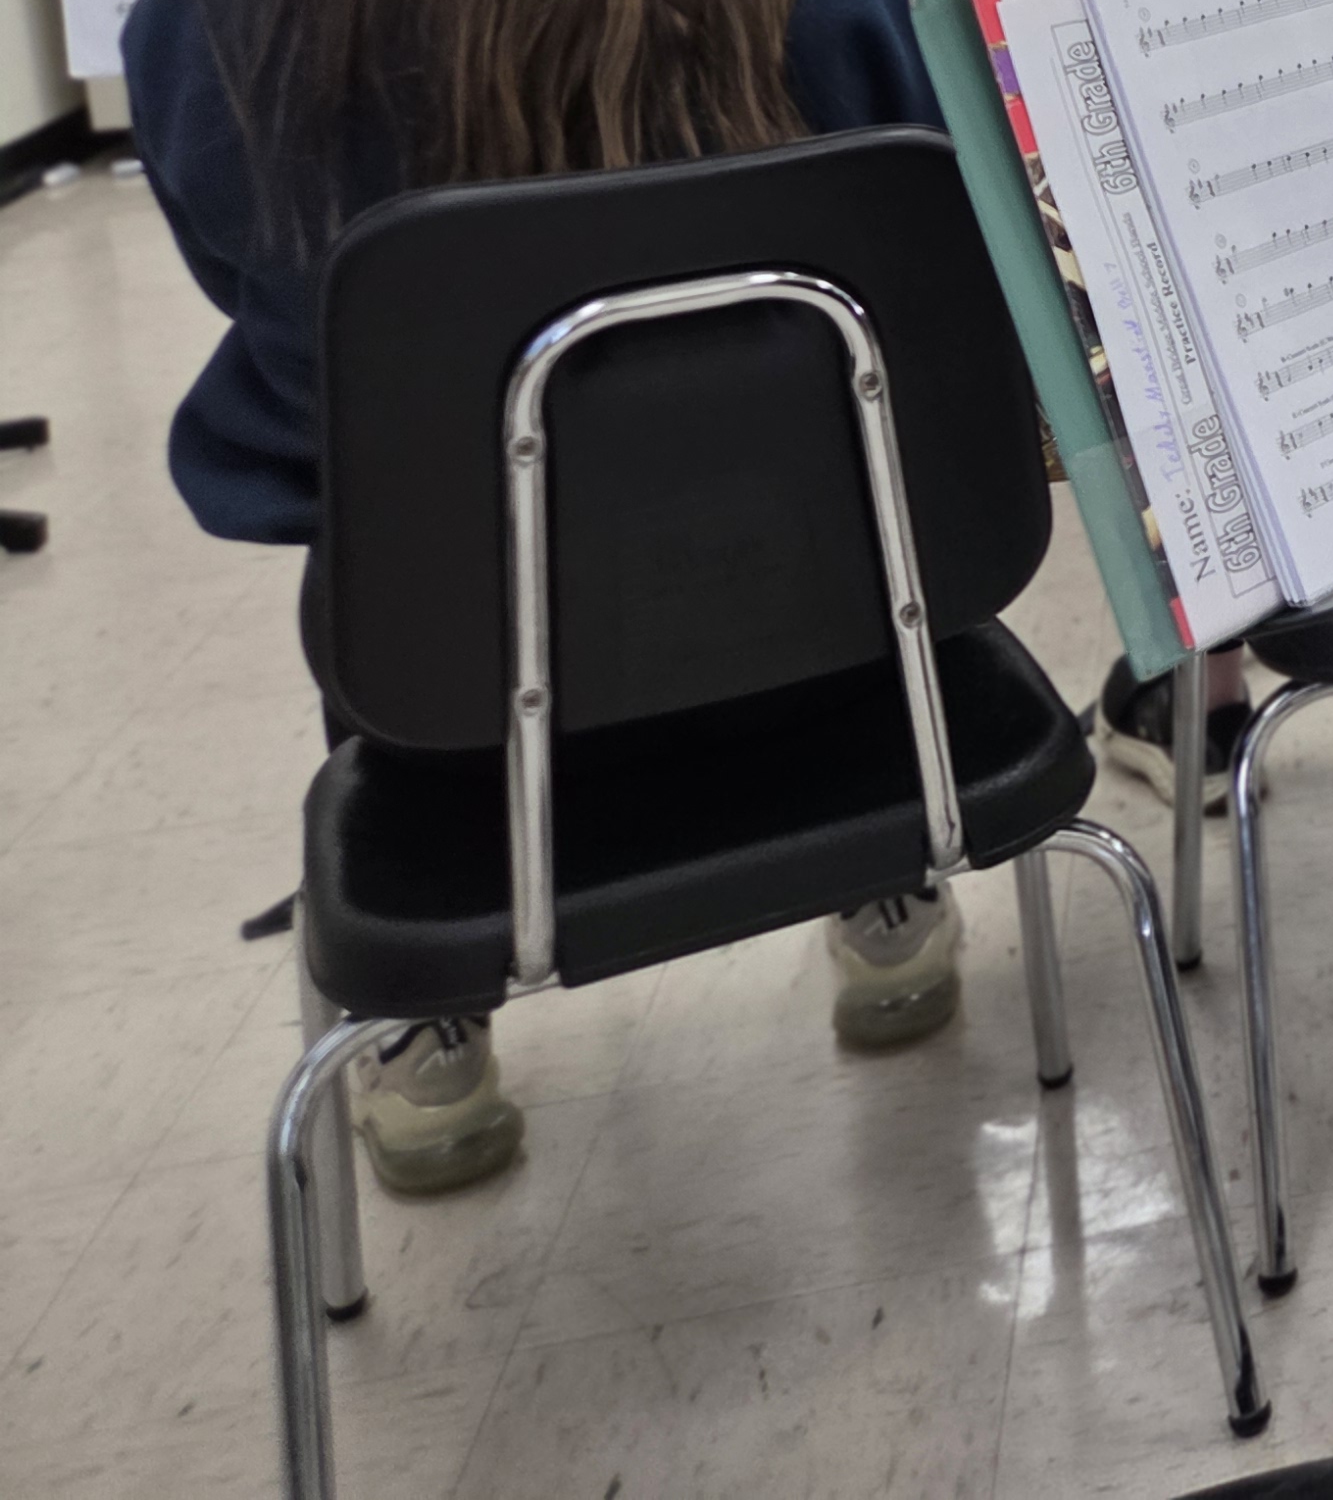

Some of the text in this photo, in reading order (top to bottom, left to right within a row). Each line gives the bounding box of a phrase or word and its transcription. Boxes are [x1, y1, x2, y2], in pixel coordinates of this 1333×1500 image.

[1064, 39, 1140, 196] 6th Grade
[1147, 241, 1197, 365] Practice Record
[1175, 488, 1216, 583] Name:
[1187, 413, 1262, 573] 6th Grade
